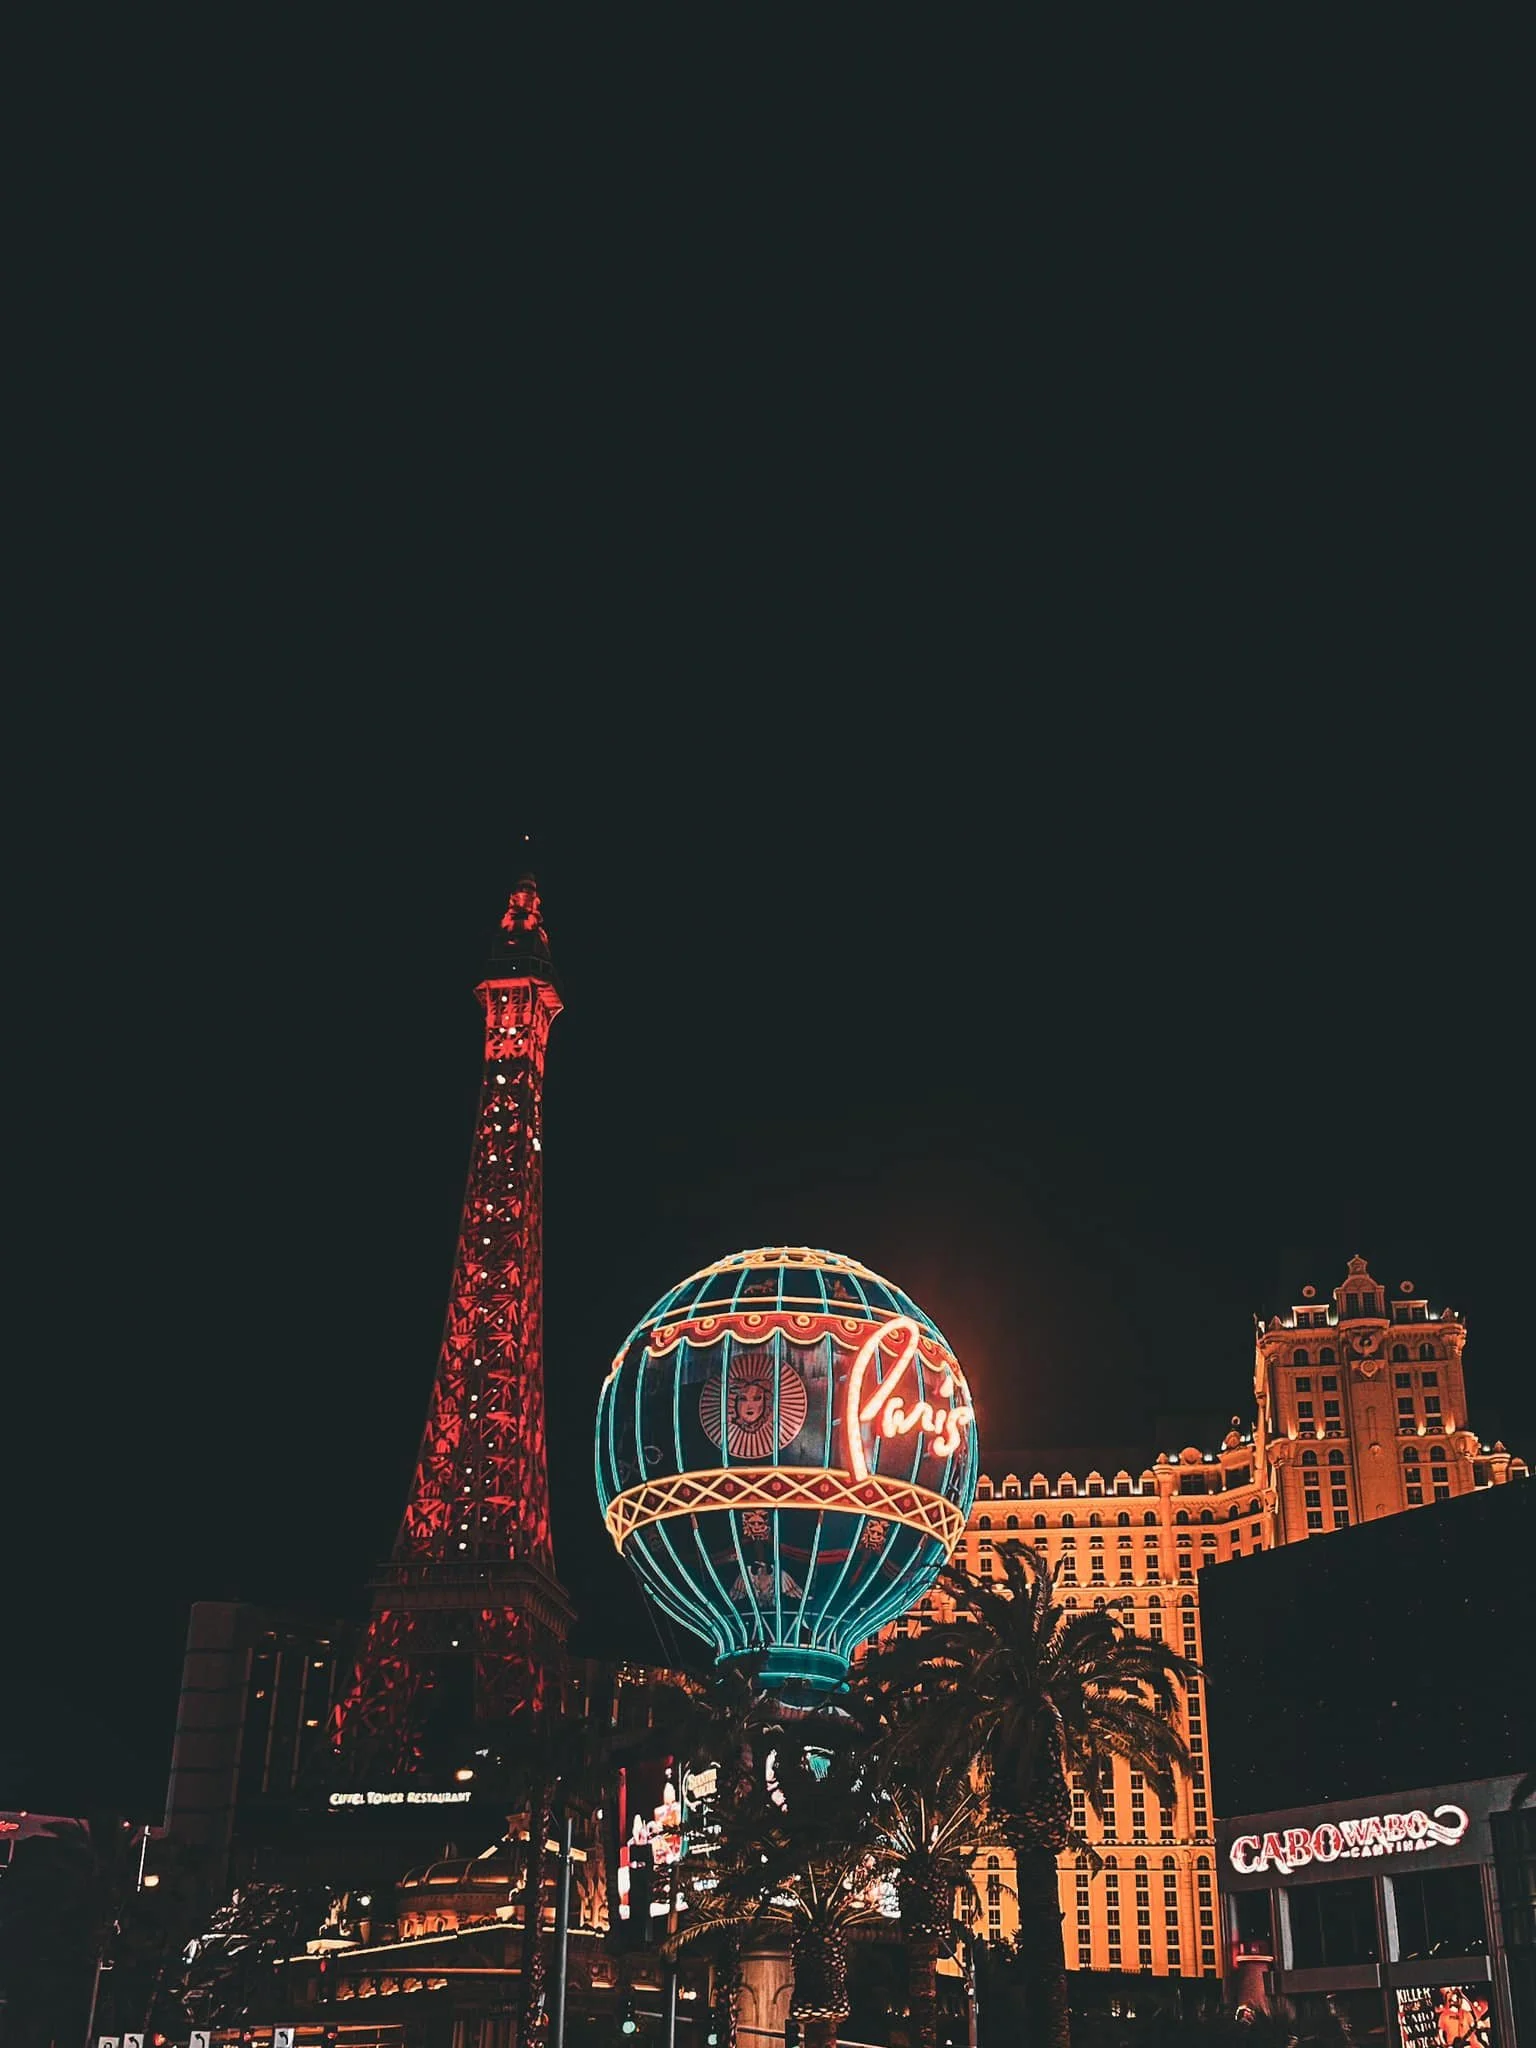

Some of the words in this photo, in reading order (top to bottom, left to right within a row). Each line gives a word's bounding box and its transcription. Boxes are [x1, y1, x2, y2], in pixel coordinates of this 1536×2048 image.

[847, 1315, 972, 1480] Paris
[329, 1792, 365, 1806] EIFFEL
[367, 1791, 404, 1805] TOWER
[407, 1791, 472, 1804] RESTAURANT
[1396, 1987, 1431, 2003] KILLER
